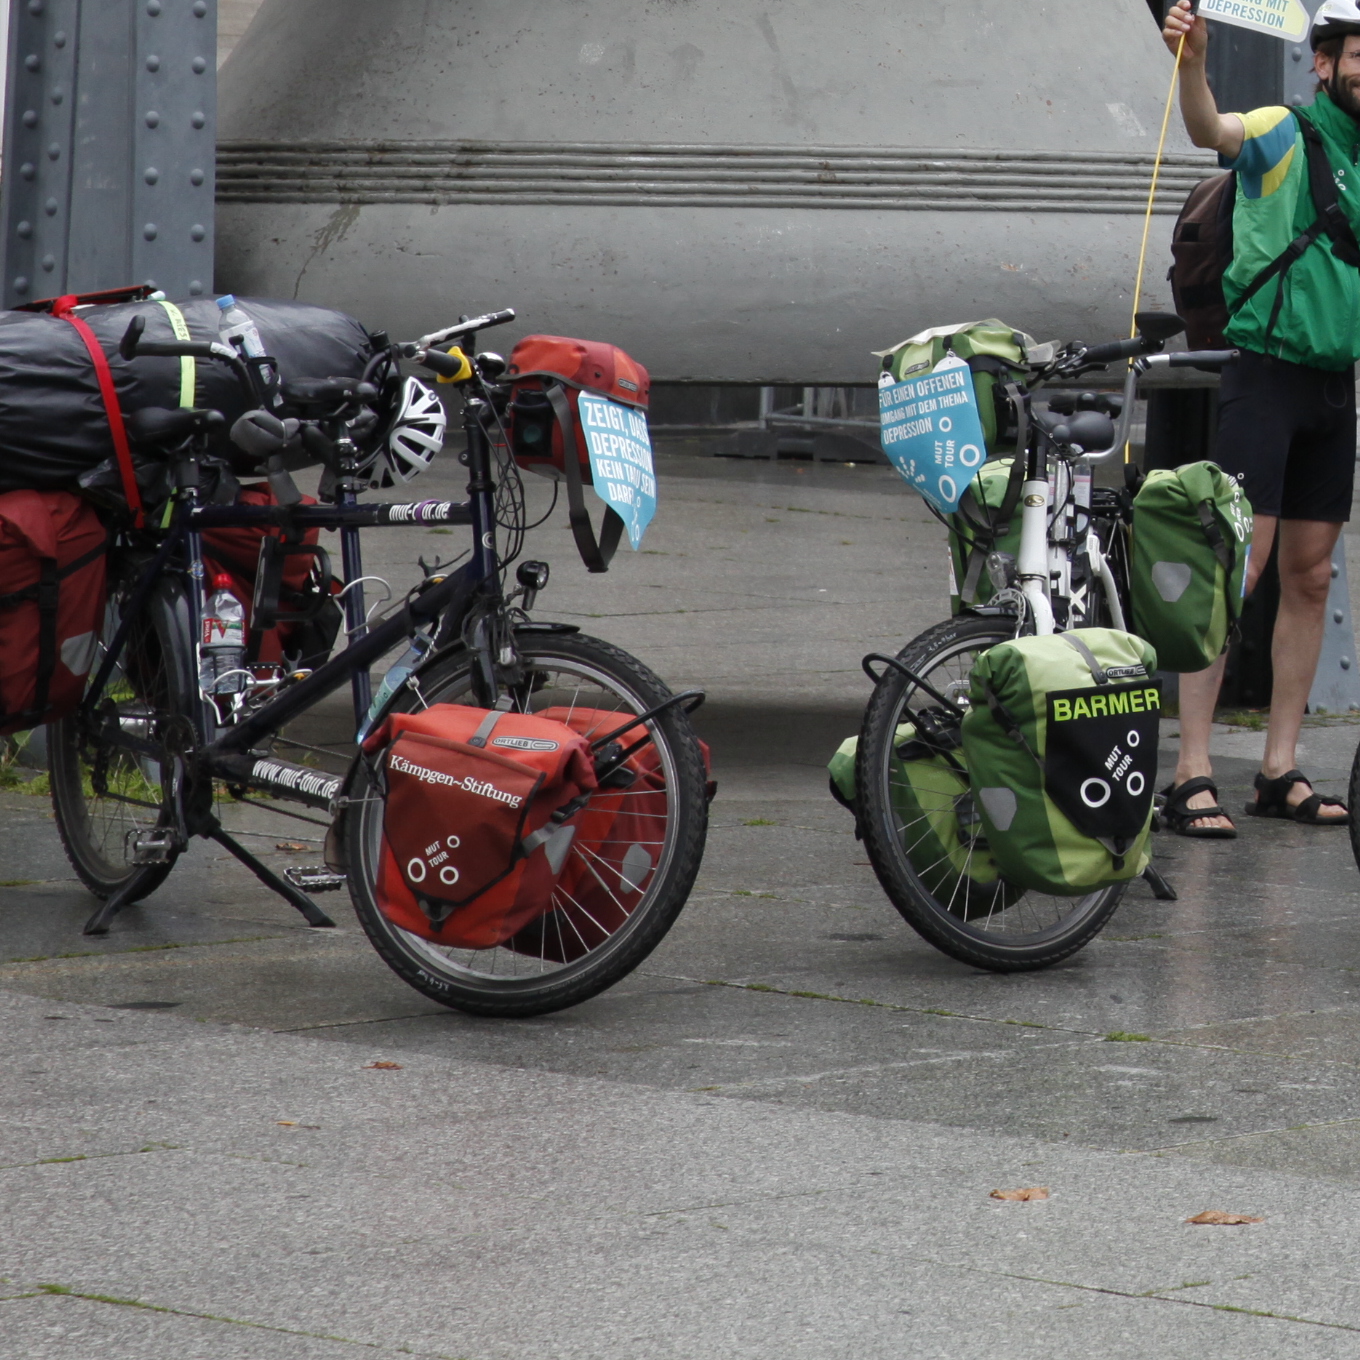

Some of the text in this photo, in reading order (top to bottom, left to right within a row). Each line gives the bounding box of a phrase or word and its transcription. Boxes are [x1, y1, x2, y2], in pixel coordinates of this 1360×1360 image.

[879, 371, 964, 408] FÜR EINEN OFFENEN
[584, 402, 629, 437] ZEIGT,
[881, 391, 968, 425] UMGANG MIT DEM THEMA
[884, 417, 932, 445] DEPRESSION
[590, 431, 654, 475] DEPRESSION
[935, 440, 943, 464] MUT
[945, 439, 955, 468] TOUR
[596, 458, 624, 481] KEIN
[389, 501, 450, 521] mut-tur.de
[1053, 688, 1160, 721] BARMER
[1104, 745, 1122, 770] MUT
[1112, 754, 1133, 781] TOUR
[252, 759, 339, 799] www.mut-tour.de
[389, 754, 523, 809] Kämpgen~Stiftung
[424, 841, 441, 857] MUT
[428, 851, 450, 868] TOUR
